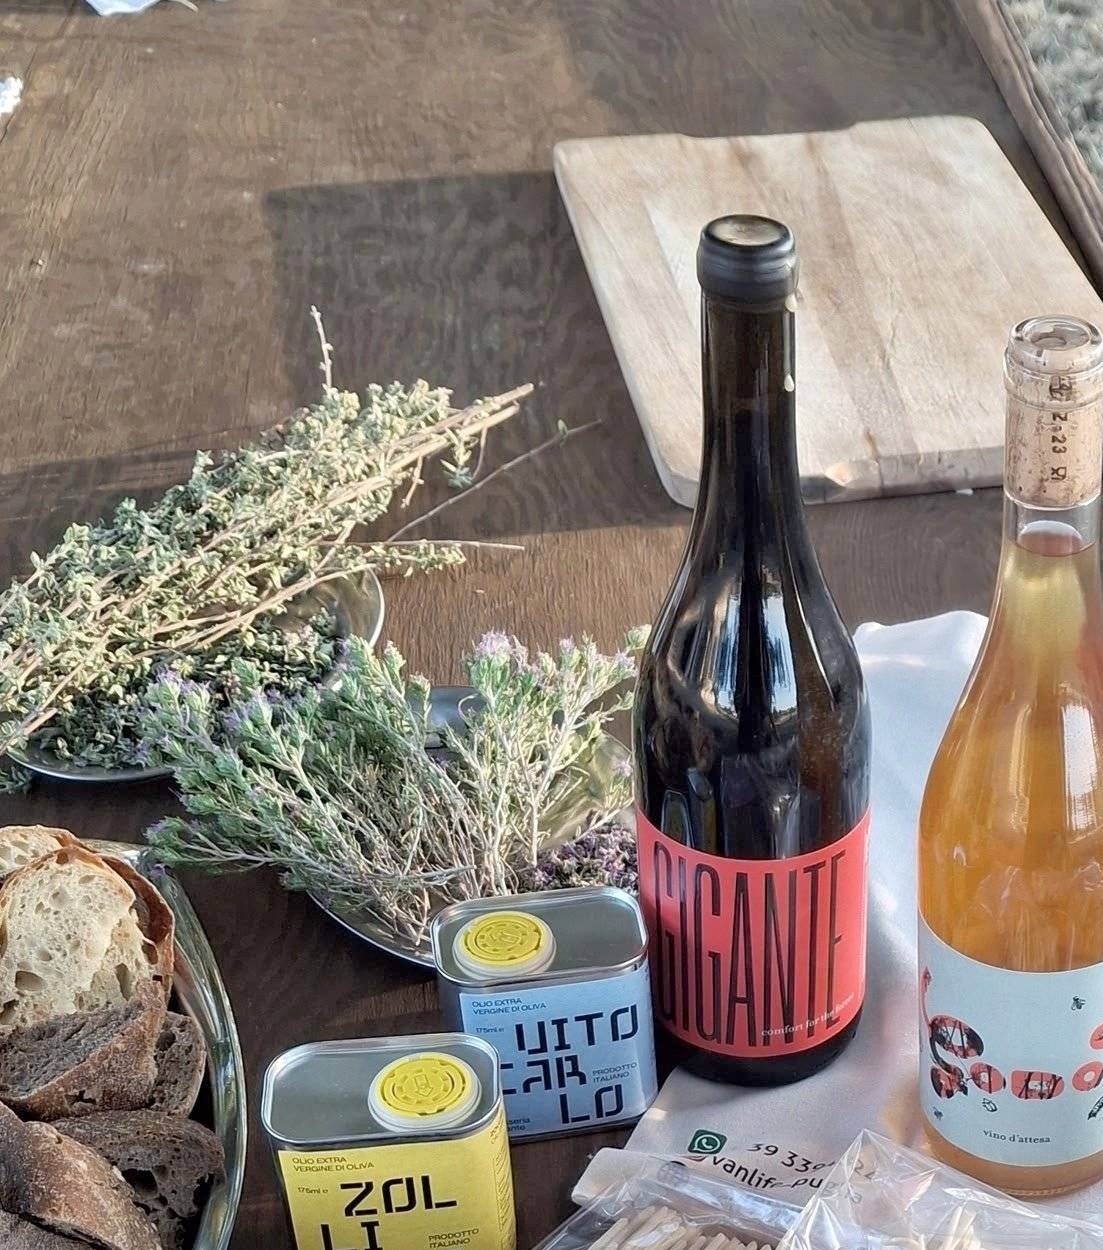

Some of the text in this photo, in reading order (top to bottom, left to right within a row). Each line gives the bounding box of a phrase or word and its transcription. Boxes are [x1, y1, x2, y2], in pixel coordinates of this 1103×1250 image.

[653, 840, 846, 1047] GIGANTE
[472, 998, 522, 1008] OLIO EXTRA
[472, 1002, 547, 1015] VERGINE DI OLIVA
[761, 1021, 803, 1036] comfort
[592, 1062, 637, 1076] PRODOTTO
[593, 1071, 630, 1084] ITALIANO
[560, 1084, 624, 1124] LO
[983, 1128, 1006, 1142] vino
[292, 1156, 347, 1165] OLIO EXTRA
[293, 1162, 375, 1173] VERGINE DI OLIVA
[340, 1175, 458, 1217] ZOL
[428, 1228, 480, 1242] PRODOTTO
[429, 1237, 471, 1249] ITALIANO
